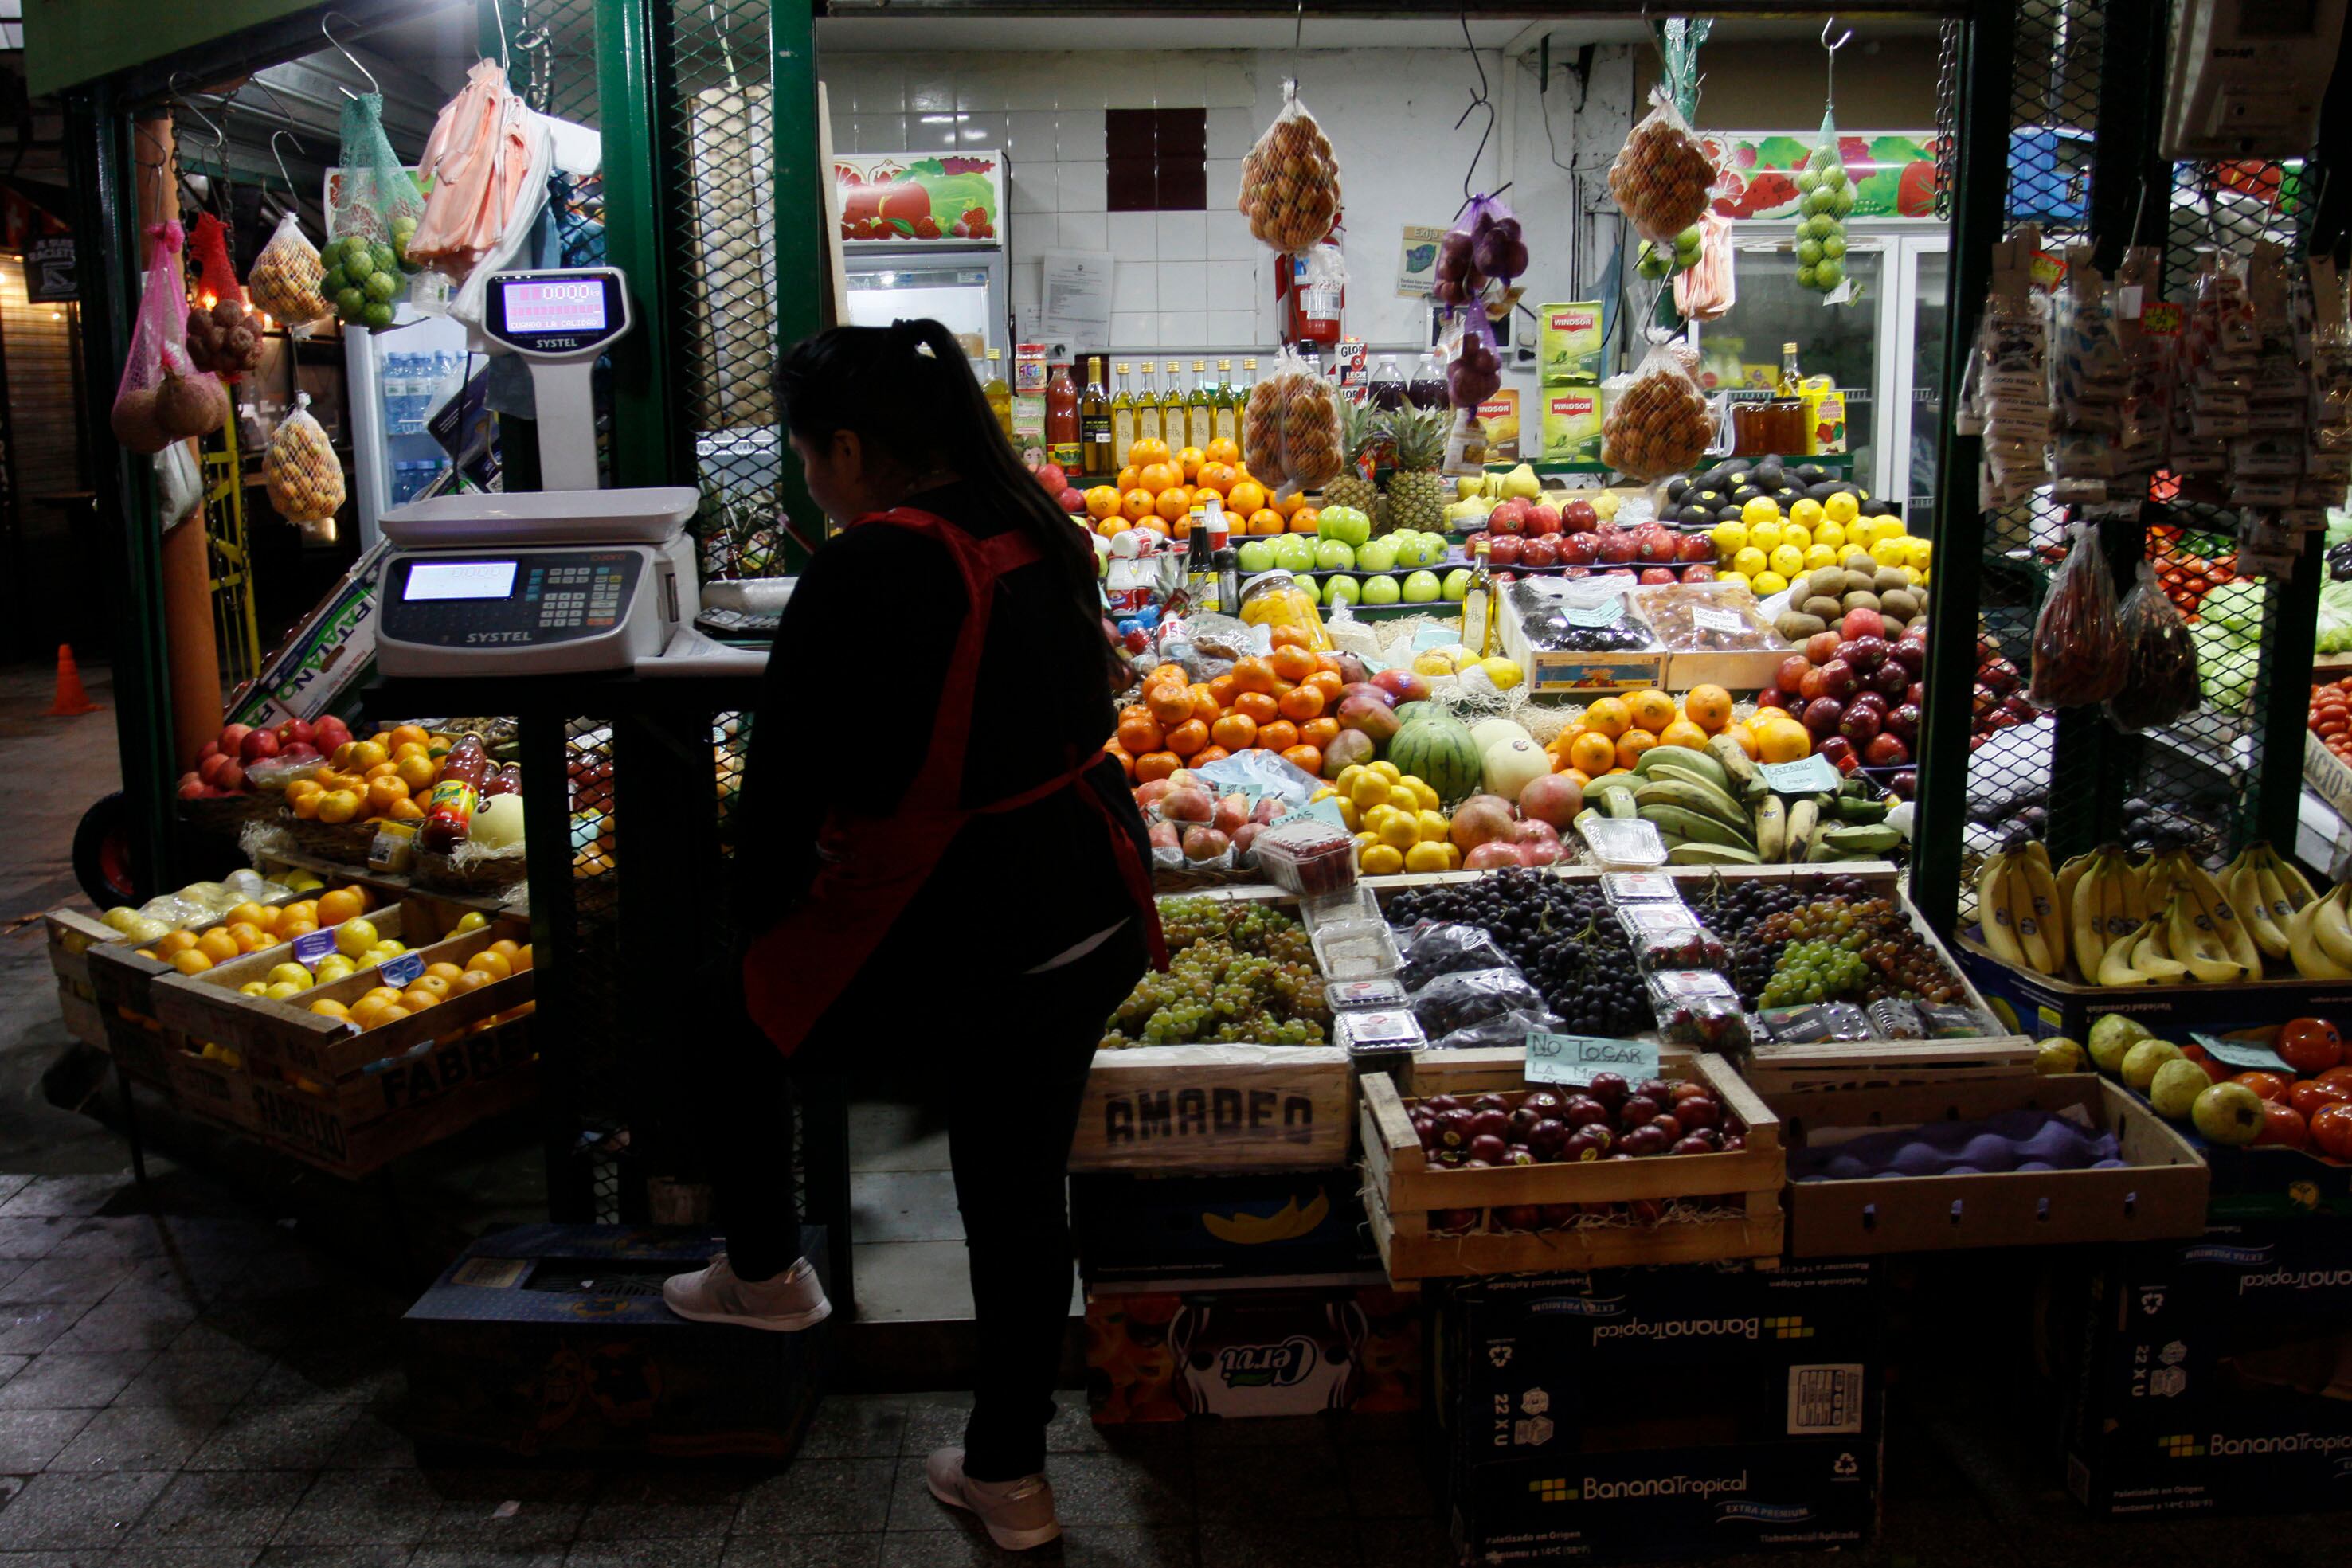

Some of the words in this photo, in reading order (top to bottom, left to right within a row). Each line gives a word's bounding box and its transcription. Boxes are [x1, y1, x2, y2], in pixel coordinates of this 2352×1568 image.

[1554, 317, 1591, 326] WINDSOR
[536, 338, 578, 348] SYSTEL
[1553, 401, 1591, 410] WINDSOR
[276, 600, 374, 701] PATALANO
[466, 631, 533, 643] SYSTEL
[382, 1025, 525, 1109] FABRE
[1106, 1087, 1313, 1144] AMADEO
[2239, 1268, 2352, 1296] anaTropical
[1593, 1316, 1759, 1347] BananaTropical
[1219, 1338, 1316, 1387] Cervi
[2209, 1432, 2352, 1457] BananaTropic
[1583, 1469, 1748, 1502] BananaTropical
[1725, 1504, 1759, 1515] EXTRA
[1759, 1507, 1810, 1518] PREMIUM
